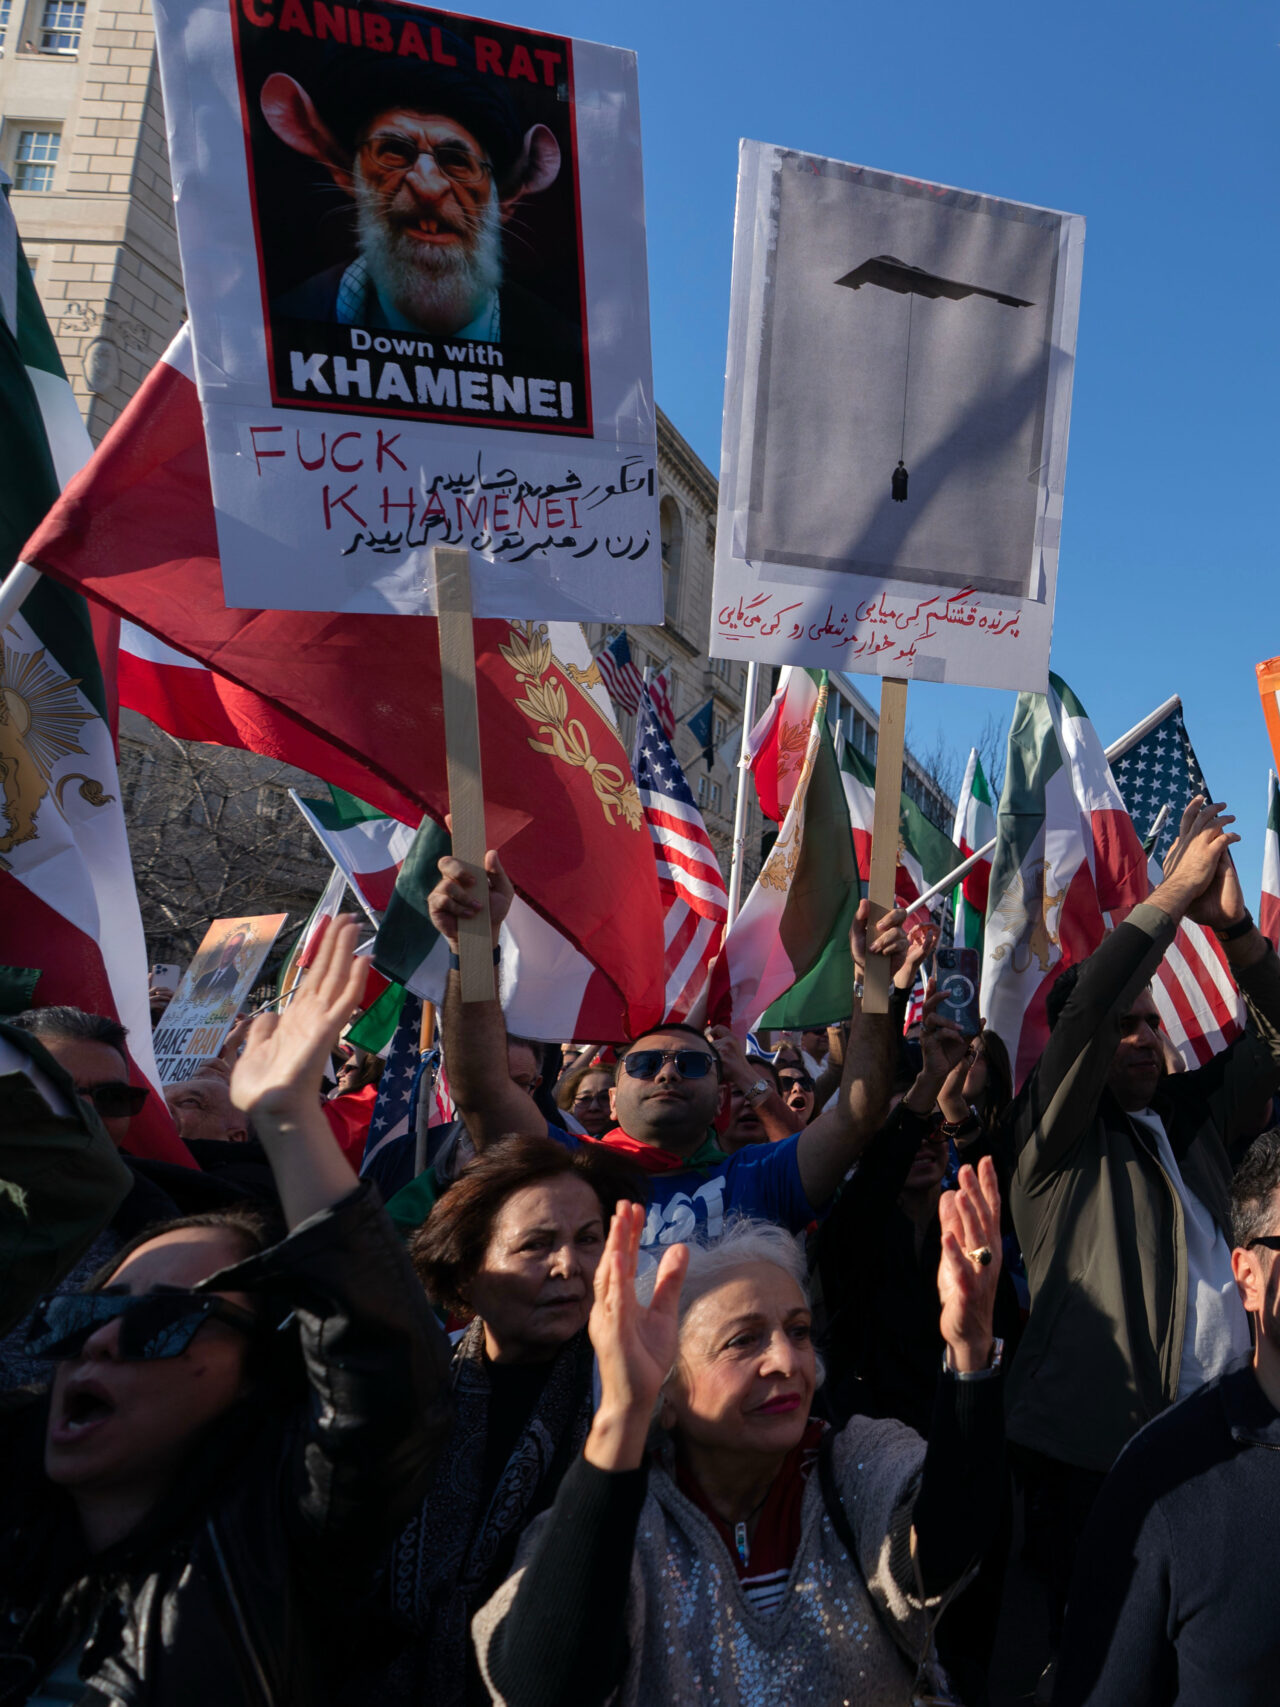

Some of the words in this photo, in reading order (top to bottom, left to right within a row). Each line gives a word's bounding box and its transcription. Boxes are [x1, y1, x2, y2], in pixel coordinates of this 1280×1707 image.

[243, 0, 457, 68] CANIBAL
[475, 35, 562, 87] RAT
[350, 327, 434, 363] Down
[443, 343, 504, 367] with
[289, 351, 574, 419] KHAMENEI
[250, 425, 408, 476] FUCK
[582, 455, 655, 511] انگور
[322, 484, 582, 532] KHAMENEI
[605, 530, 651, 561] زن
[153, 1028, 193, 1055] MAKE
[184, 1027, 224, 1055] IRAN
